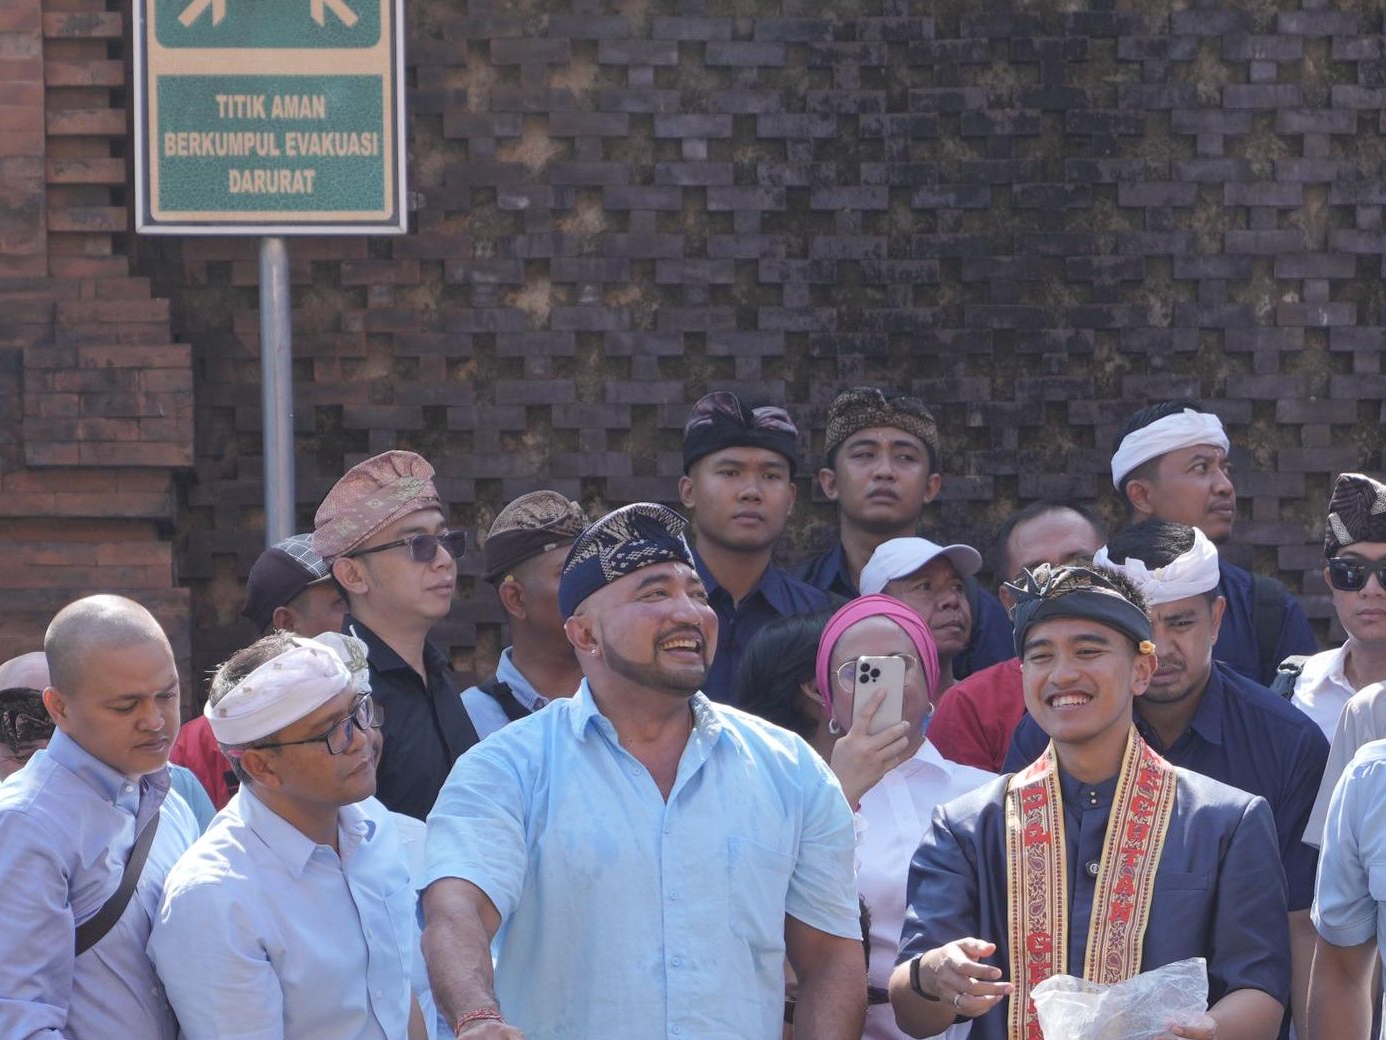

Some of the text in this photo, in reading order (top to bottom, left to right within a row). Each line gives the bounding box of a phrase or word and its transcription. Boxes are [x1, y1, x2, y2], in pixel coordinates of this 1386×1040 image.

[216, 95, 326, 118] TITIK AMAN
[164, 132, 379, 156] BERKUMPUL EVAKUASI
[229, 169, 316, 193] DARURAT
